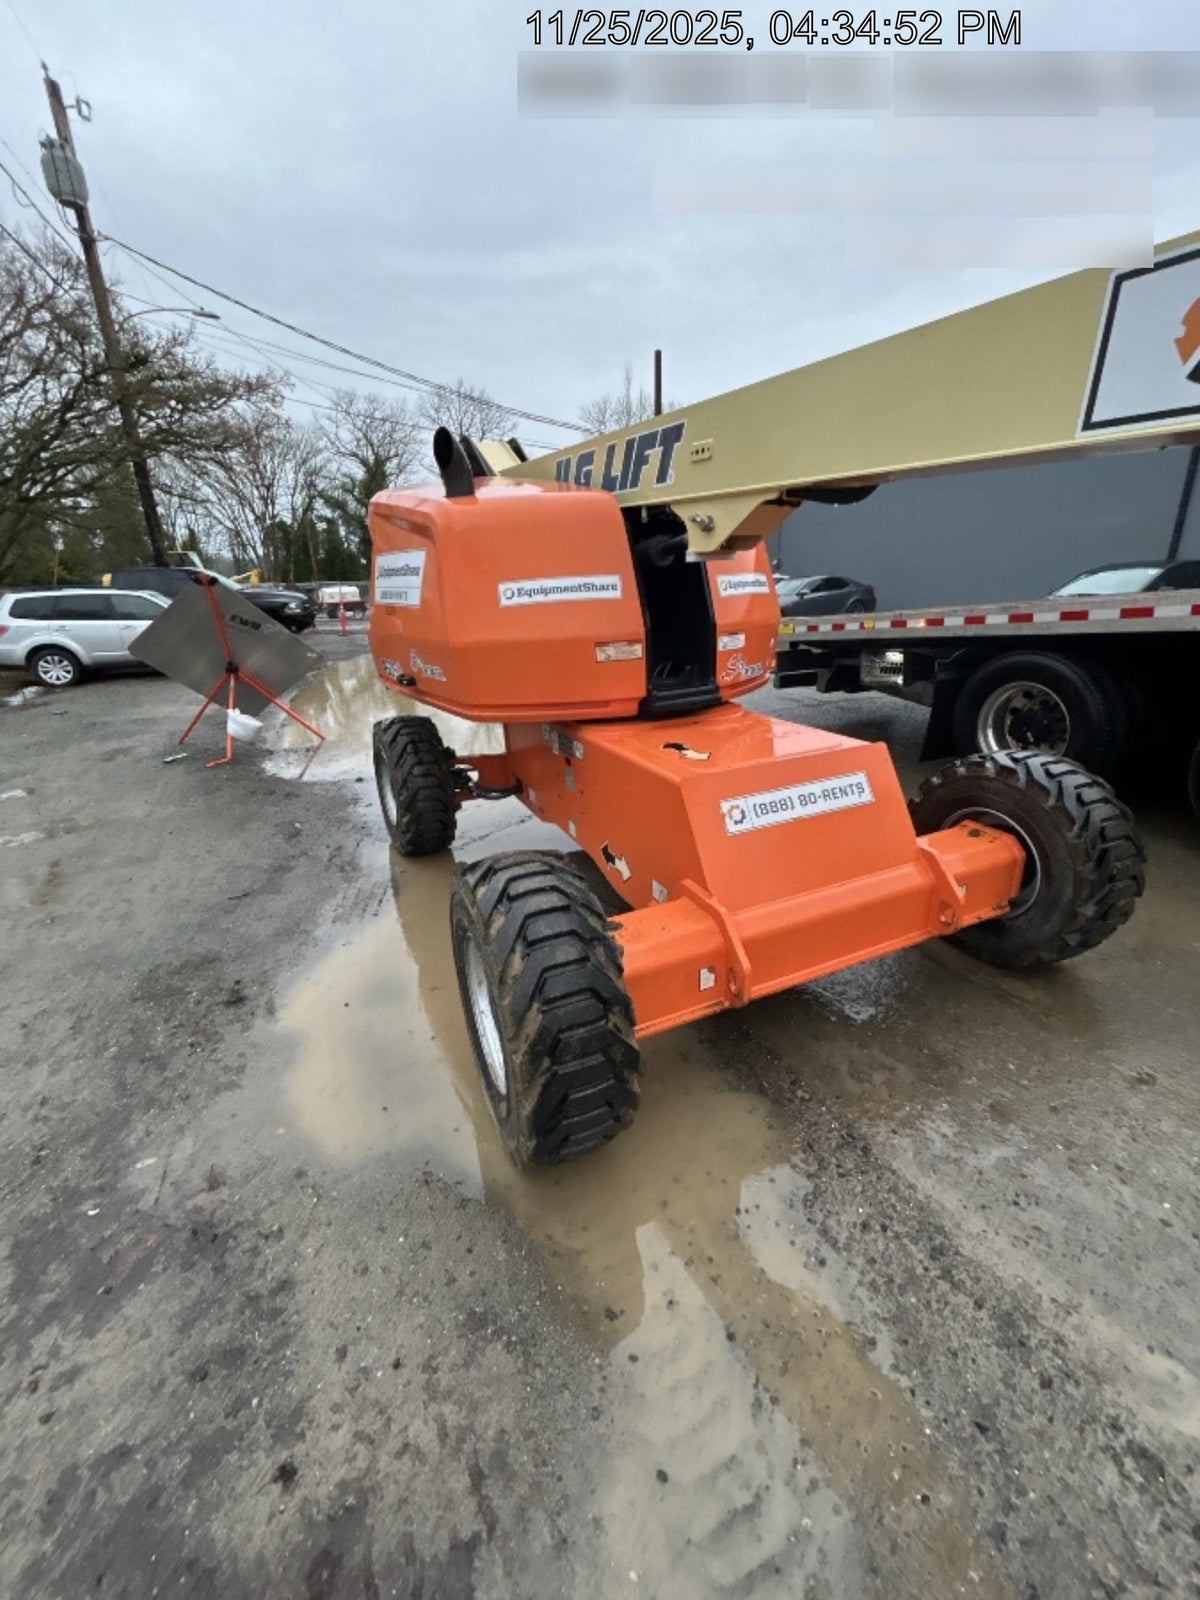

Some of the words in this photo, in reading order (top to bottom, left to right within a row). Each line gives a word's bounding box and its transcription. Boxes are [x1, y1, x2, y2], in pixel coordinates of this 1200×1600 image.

[601, 420, 685, 493] LIFT
[516, 582, 618, 598] EquipmentShare
[752, 796, 795, 818] (888)
[797, 781, 866, 808] 80-RENTS
